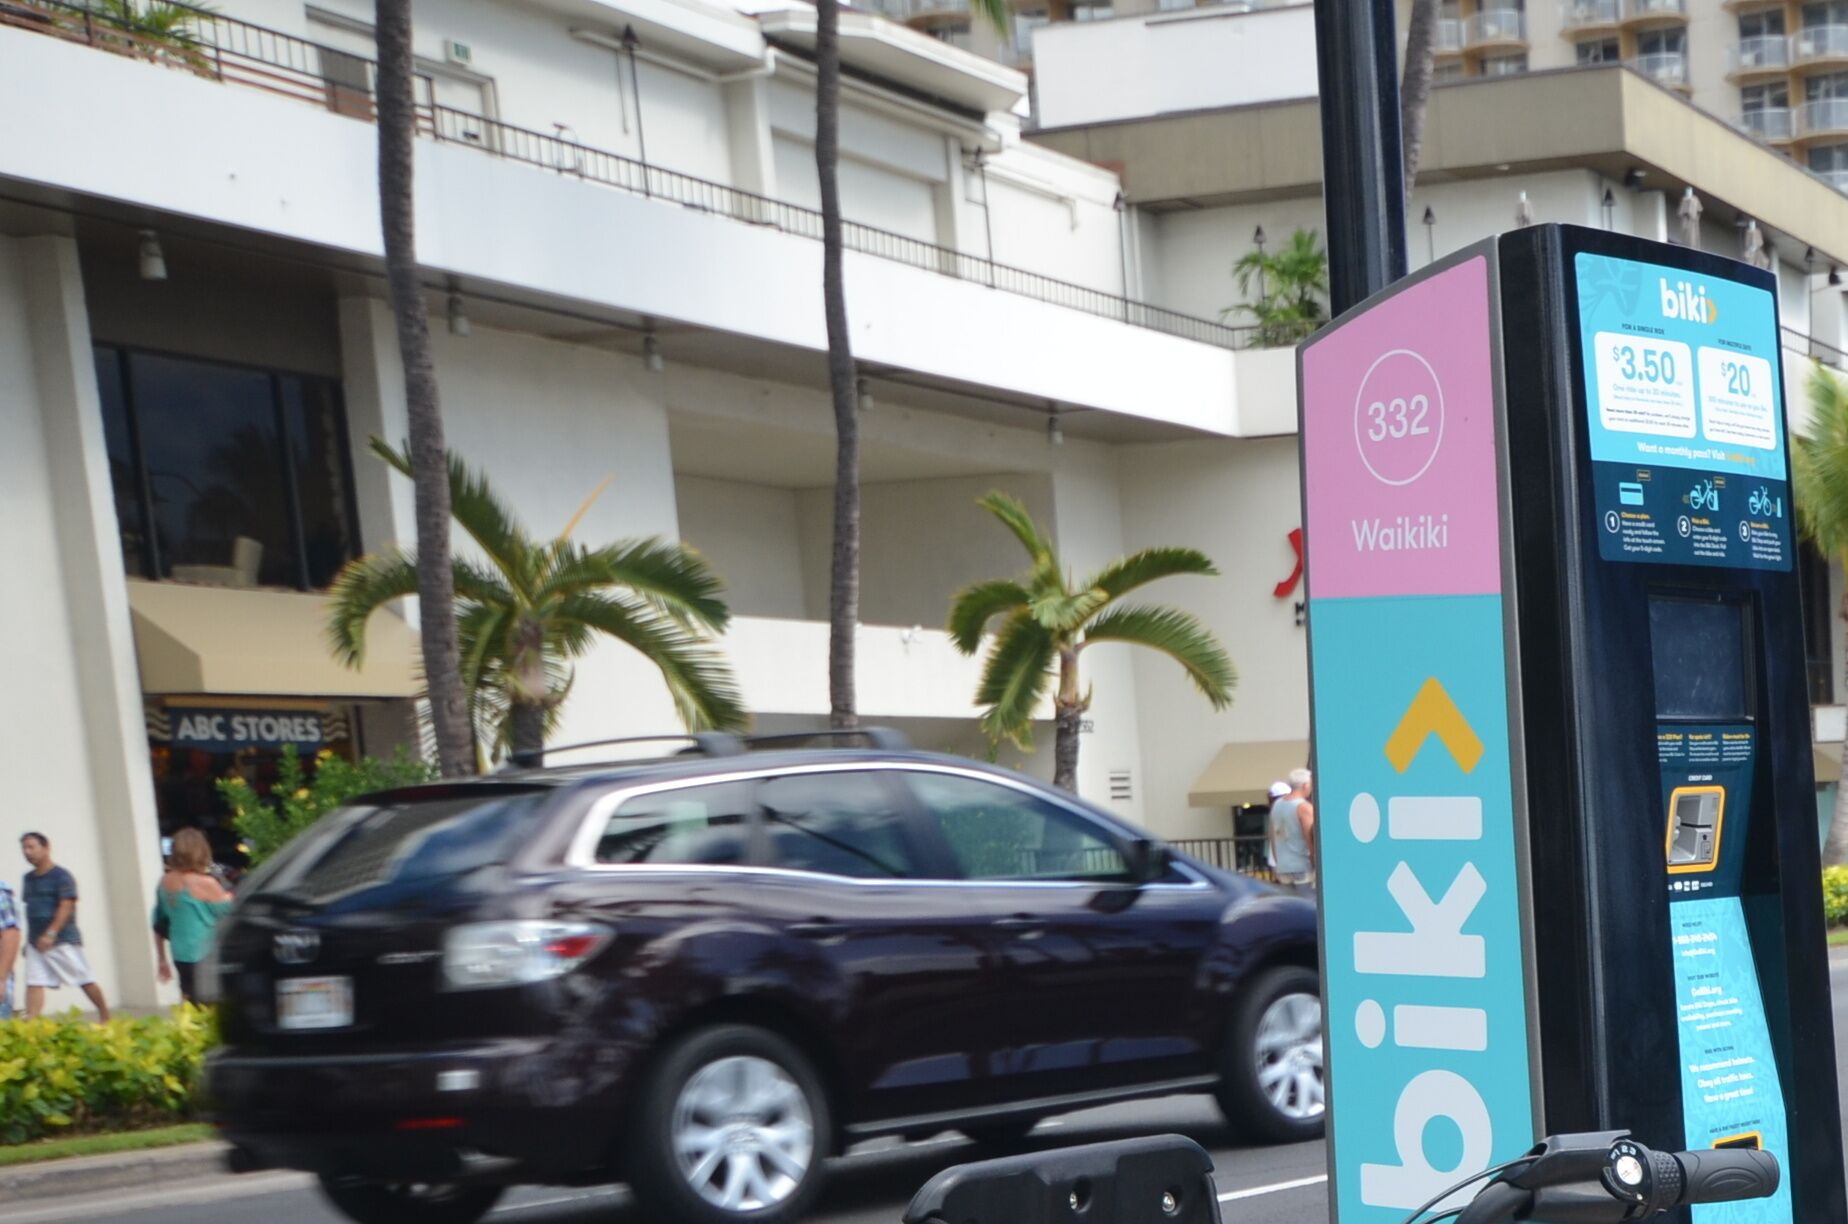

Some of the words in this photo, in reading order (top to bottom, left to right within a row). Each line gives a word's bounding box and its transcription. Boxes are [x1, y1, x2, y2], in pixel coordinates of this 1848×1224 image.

[1660, 278, 1707, 324] biki
[1613, 346, 1675, 385] $3.50
[1721, 361, 1750, 396] $20
[1368, 394, 1429, 441] 332
[1352, 514, 1448, 551] Waikiki
[1610, 516, 1615, 527] 1
[1681, 521, 1687, 532] 2
[177, 715, 227, 741] ABC
[231, 716, 321, 742] STORES
[1349, 792, 1492, 1213] biki
